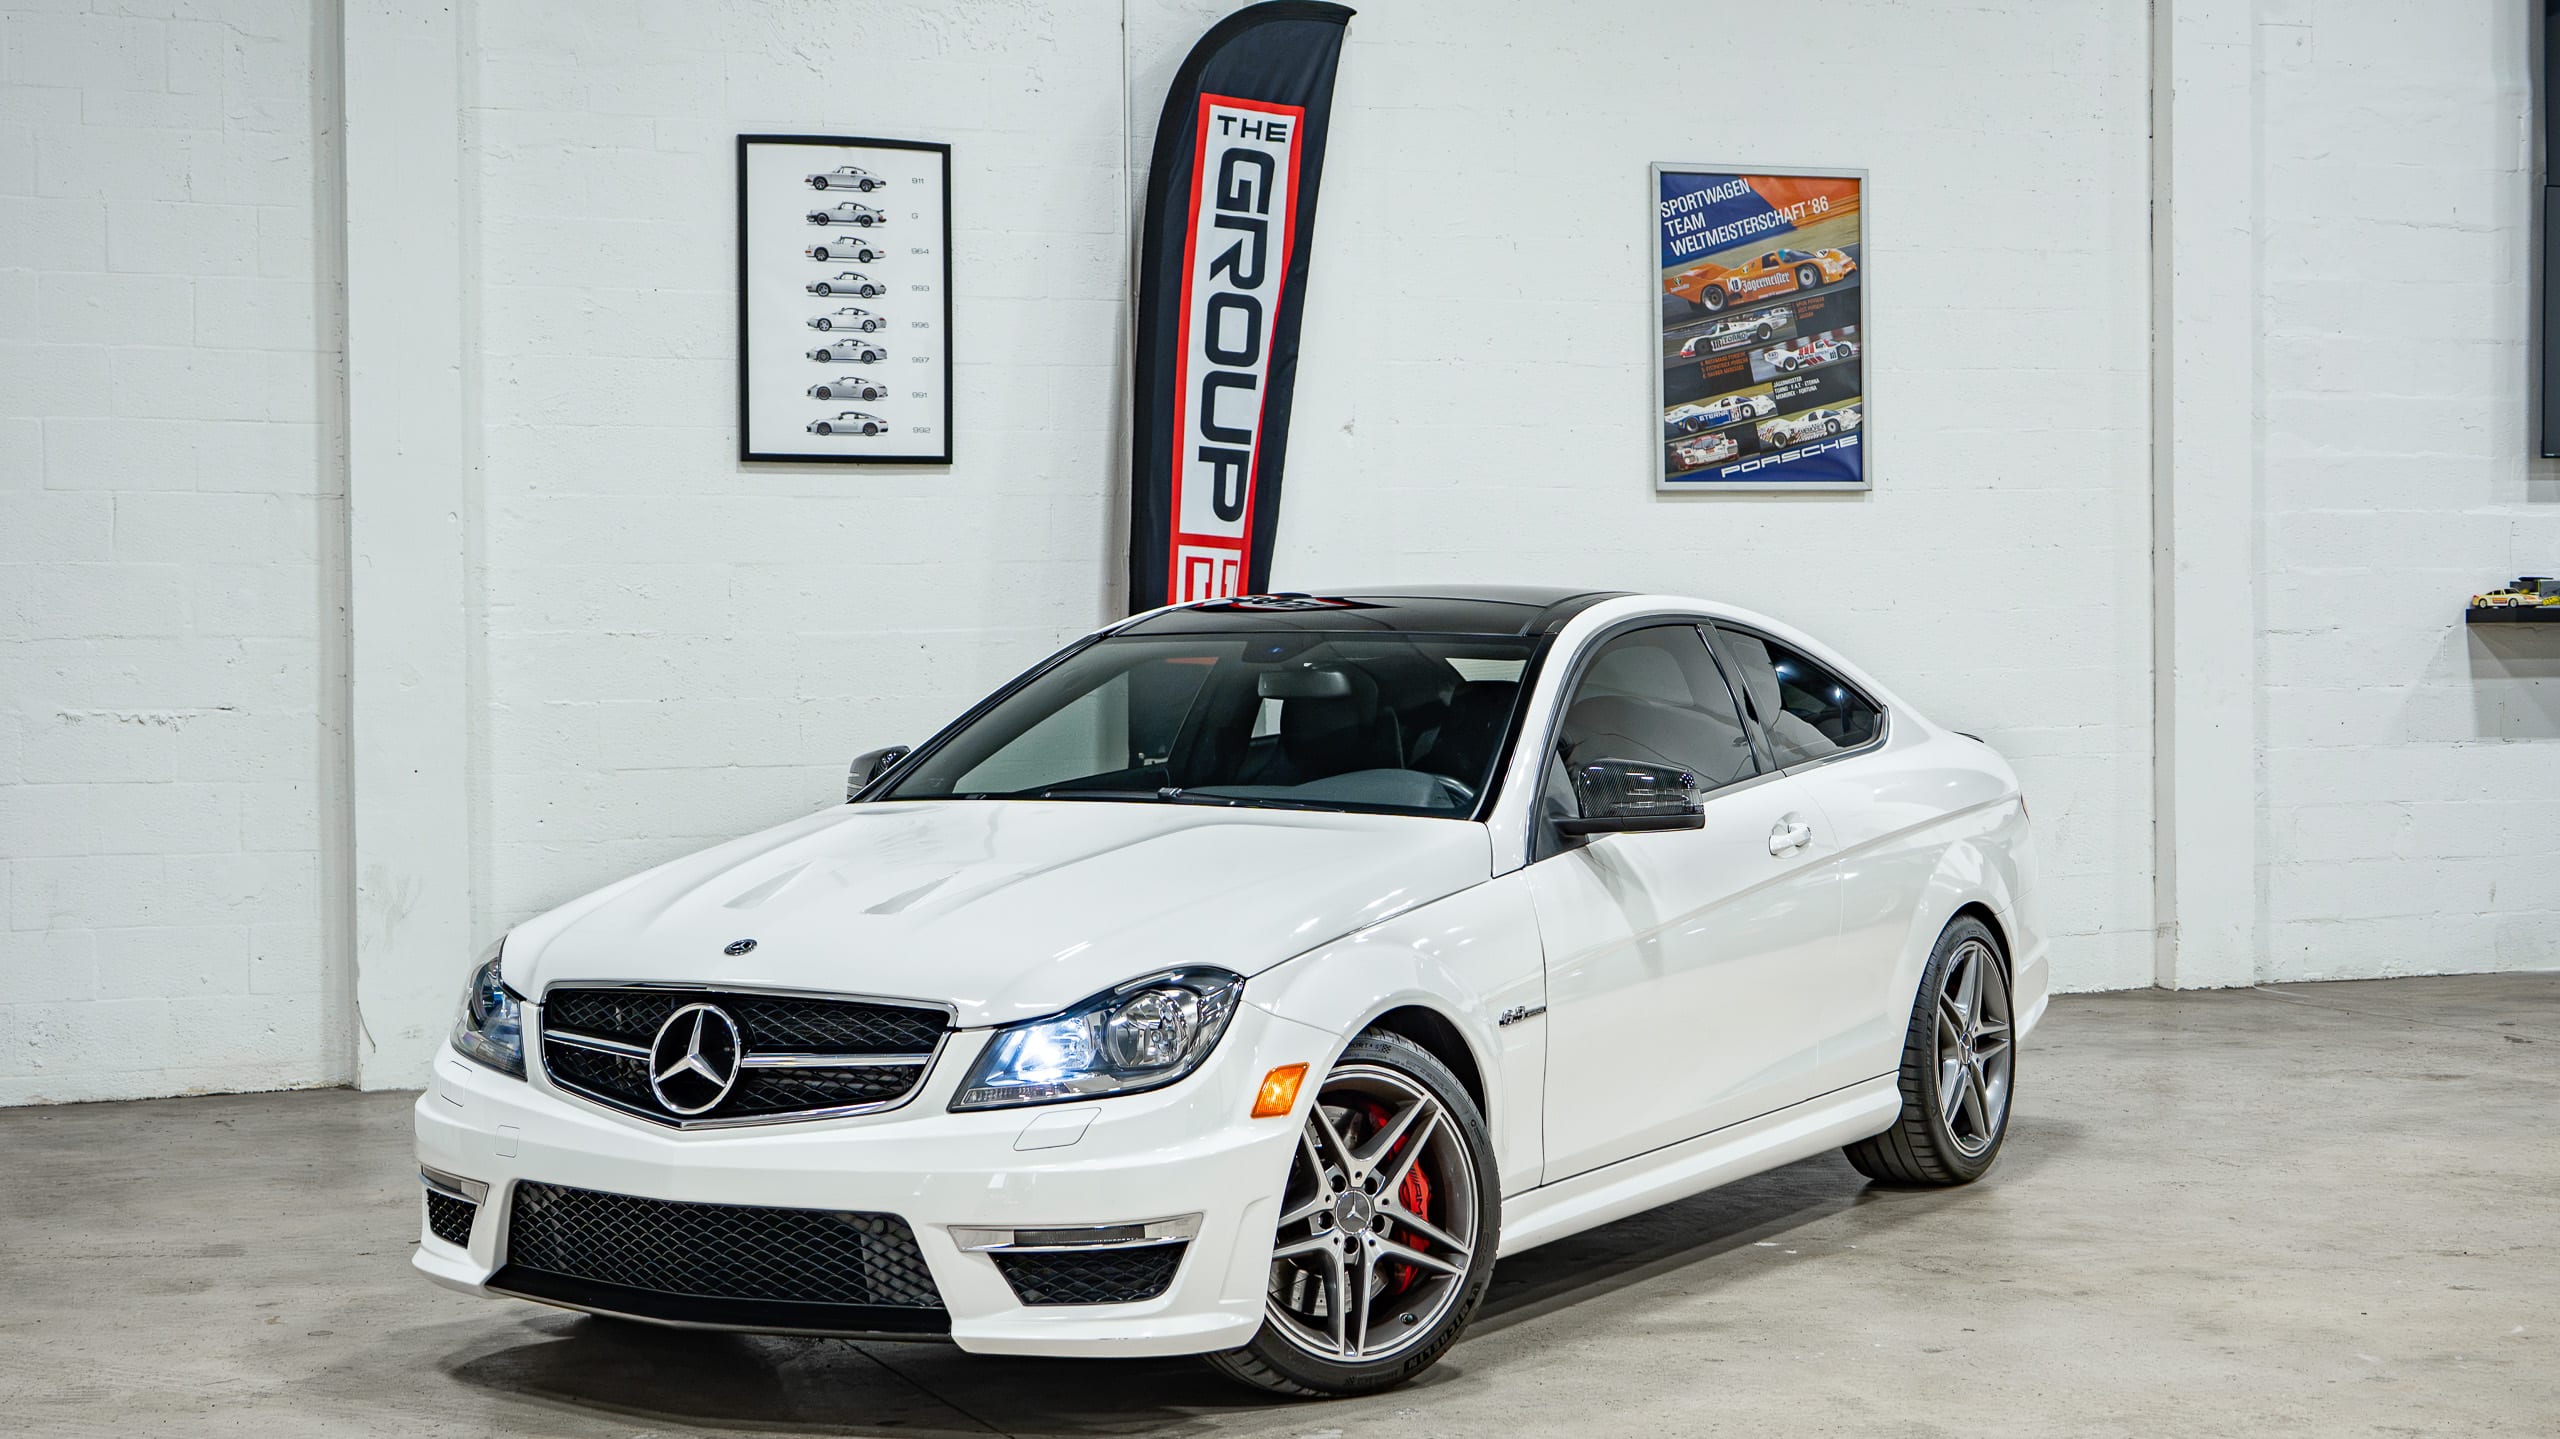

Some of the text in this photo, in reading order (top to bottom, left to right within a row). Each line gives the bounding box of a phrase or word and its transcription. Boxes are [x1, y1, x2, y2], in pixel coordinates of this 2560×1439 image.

[1217, 114, 1288, 144] THE
[1661, 178, 1750, 218] SPORTWAGEN
[1664, 212, 1706, 237] TEAM
[1670, 202, 1806, 256] WELTMEISTERSCHAFT
[1198, 146, 1275, 523] GROUP
[1720, 435, 1858, 478] PORSCHE
